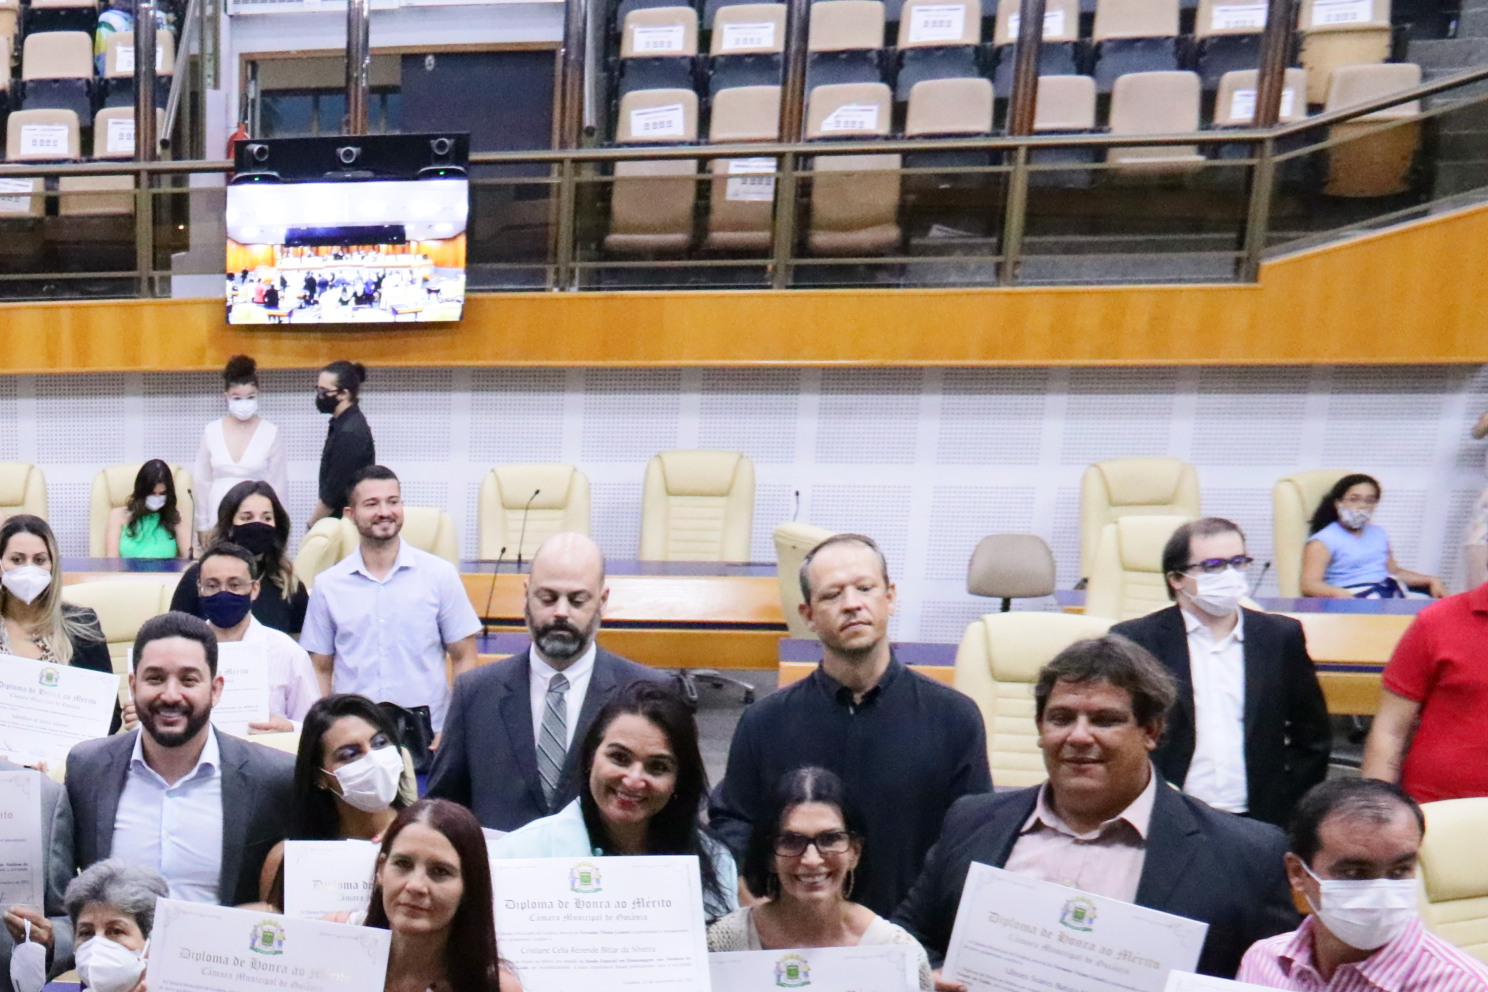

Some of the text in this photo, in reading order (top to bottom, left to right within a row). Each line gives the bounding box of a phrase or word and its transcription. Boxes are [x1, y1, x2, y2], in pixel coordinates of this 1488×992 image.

[503, 895, 671, 911] Diploma de Honra ao Mérito
[178, 946, 229, 965] Diploma
[232, 955, 245, 968] de
[250, 956, 288, 974] Honra
